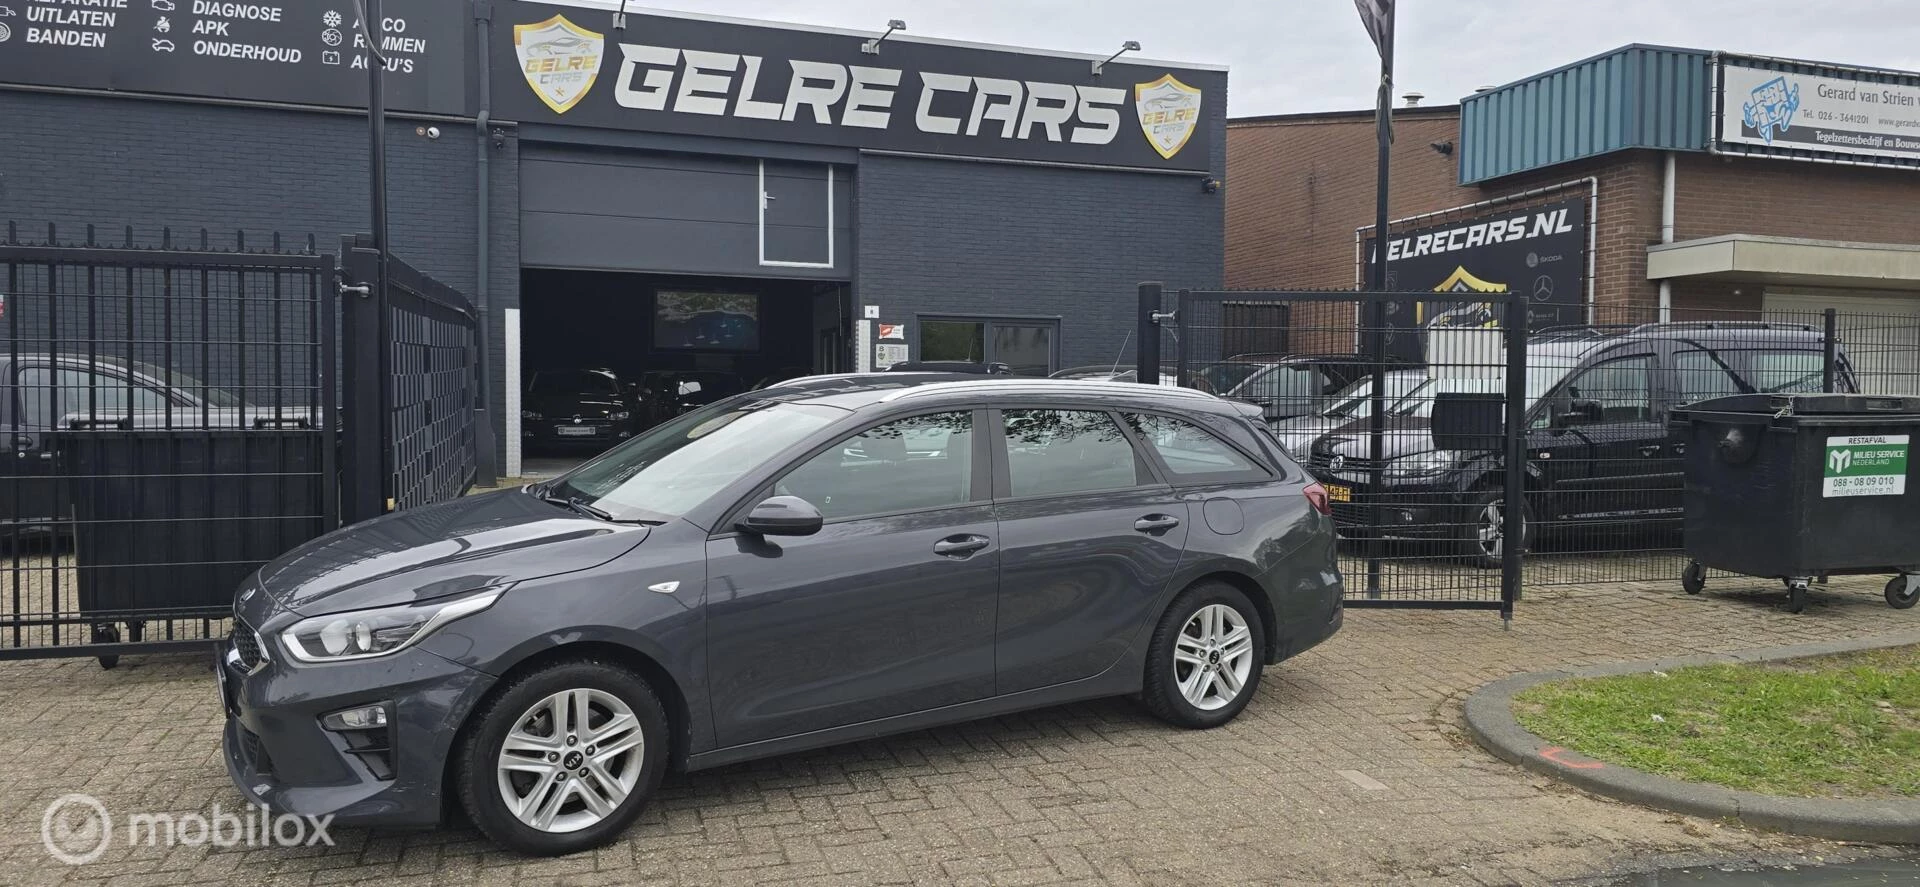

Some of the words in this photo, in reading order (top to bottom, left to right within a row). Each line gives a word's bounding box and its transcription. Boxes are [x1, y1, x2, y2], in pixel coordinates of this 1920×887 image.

[26, 6, 116, 28] UITLATEN
[192, 0, 282, 22] DIAGNOSE
[26, 27, 106, 48] BANDEN
[192, 19, 230, 37] APK
[193, 40, 302, 63] ONDERHOUD
[525, 55, 598, 74] GELRE
[614, 43, 902, 129] GELRE
[915, 72, 1126, 145] CARS
[1817, 83, 1856, 101] Gerard
[1860, 91, 1878, 103] van
[1882, 90, 1914, 106] Strien
[1803, 109, 1814, 119] Tel.
[1818, 111, 1833, 121] 026
[1840, 113, 1869, 124] 3641201
[1815, 130, 1883, 149] Tegelzettersbedrijf
[1884, 139, 1894, 147] en
[1372, 208, 1573, 263] ELRECARS.NL
[1853, 451, 1876, 459] MILIEU
[1877, 450, 1905, 458] SERVICE
[1832, 486, 1894, 496] milieuservice.nl
[1833, 479, 1847, 487] 088
[1854, 478, 1864, 486] 08
[1866, 477, 1876, 486] 09
[1878, 477, 1895, 485] 010
